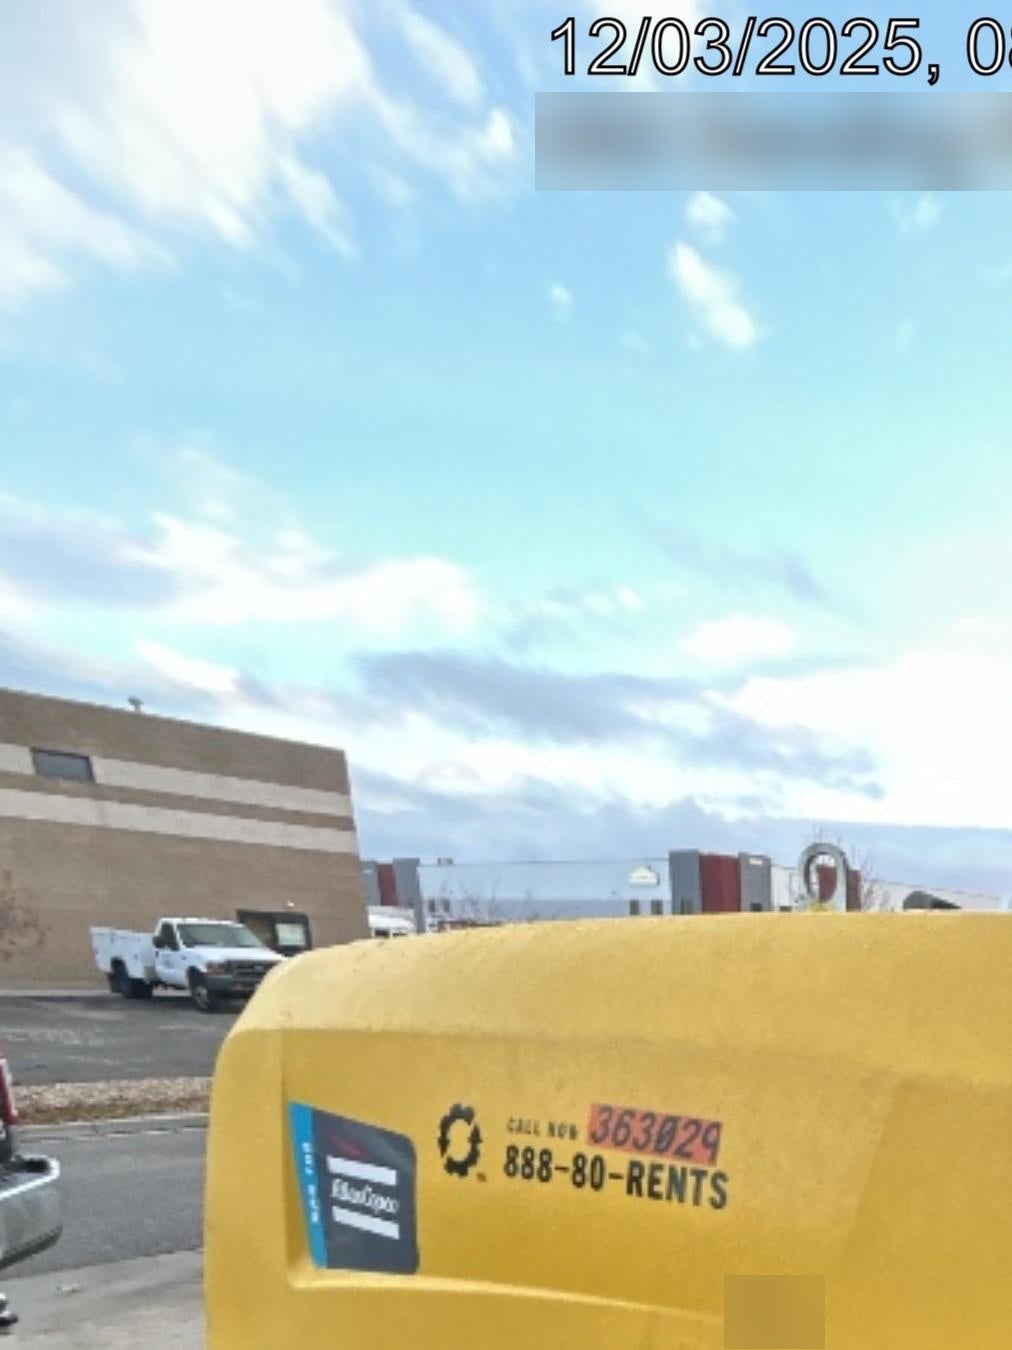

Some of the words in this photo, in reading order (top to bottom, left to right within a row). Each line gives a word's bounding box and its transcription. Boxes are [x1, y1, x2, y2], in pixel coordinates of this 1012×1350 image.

[506, 1116, 540, 1136] CALL
[548, 1120, 577, 1140] NOW
[589, 1106, 723, 1166] 363029
[503, 1144, 729, 1210] 888-80-RENTS
